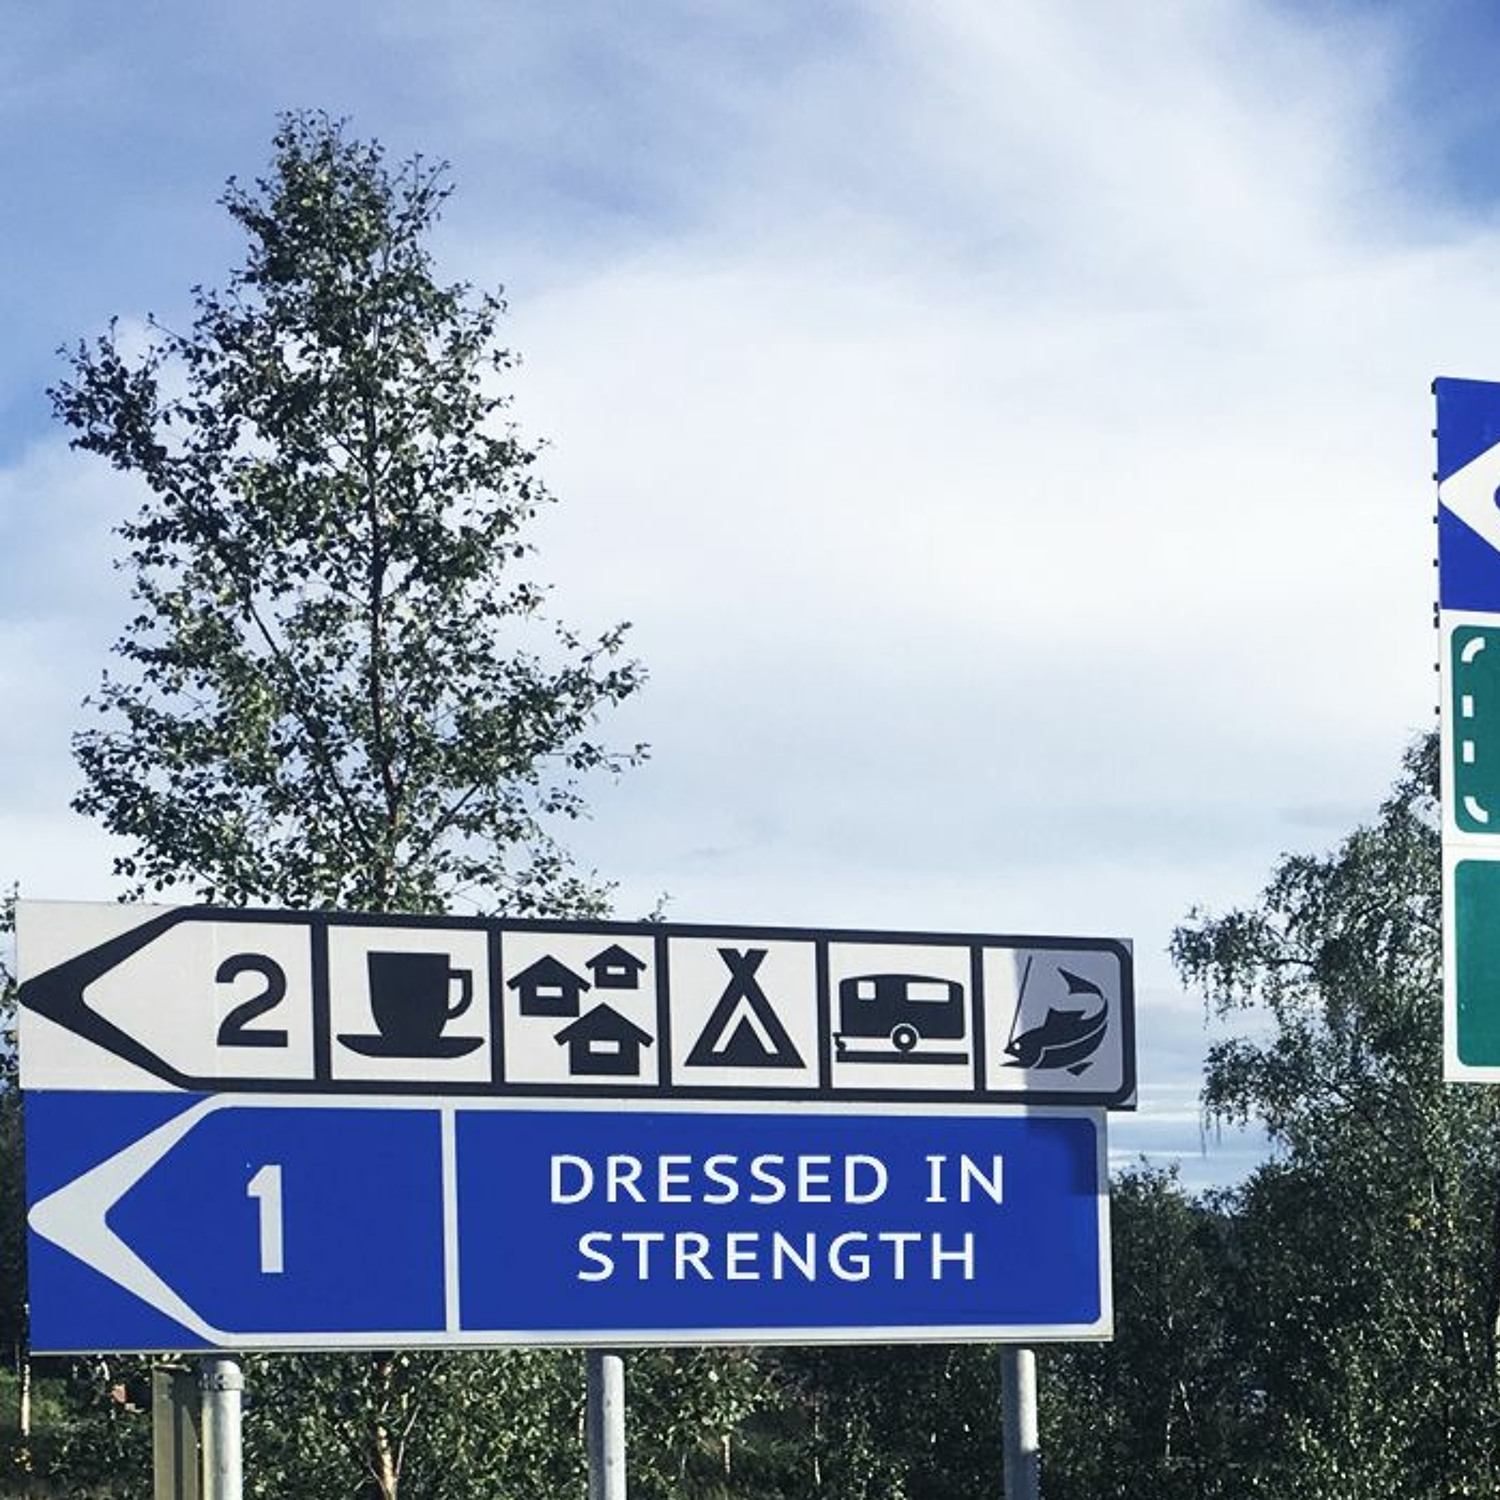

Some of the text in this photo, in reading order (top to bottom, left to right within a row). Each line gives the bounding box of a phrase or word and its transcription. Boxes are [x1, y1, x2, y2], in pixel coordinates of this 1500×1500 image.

[215, 952, 289, 1048] 2
[551, 1154, 1003, 1204] DRESSED IN
[248, 1165, 283, 1273] 1
[578, 1231, 974, 1282] STRENGTH
